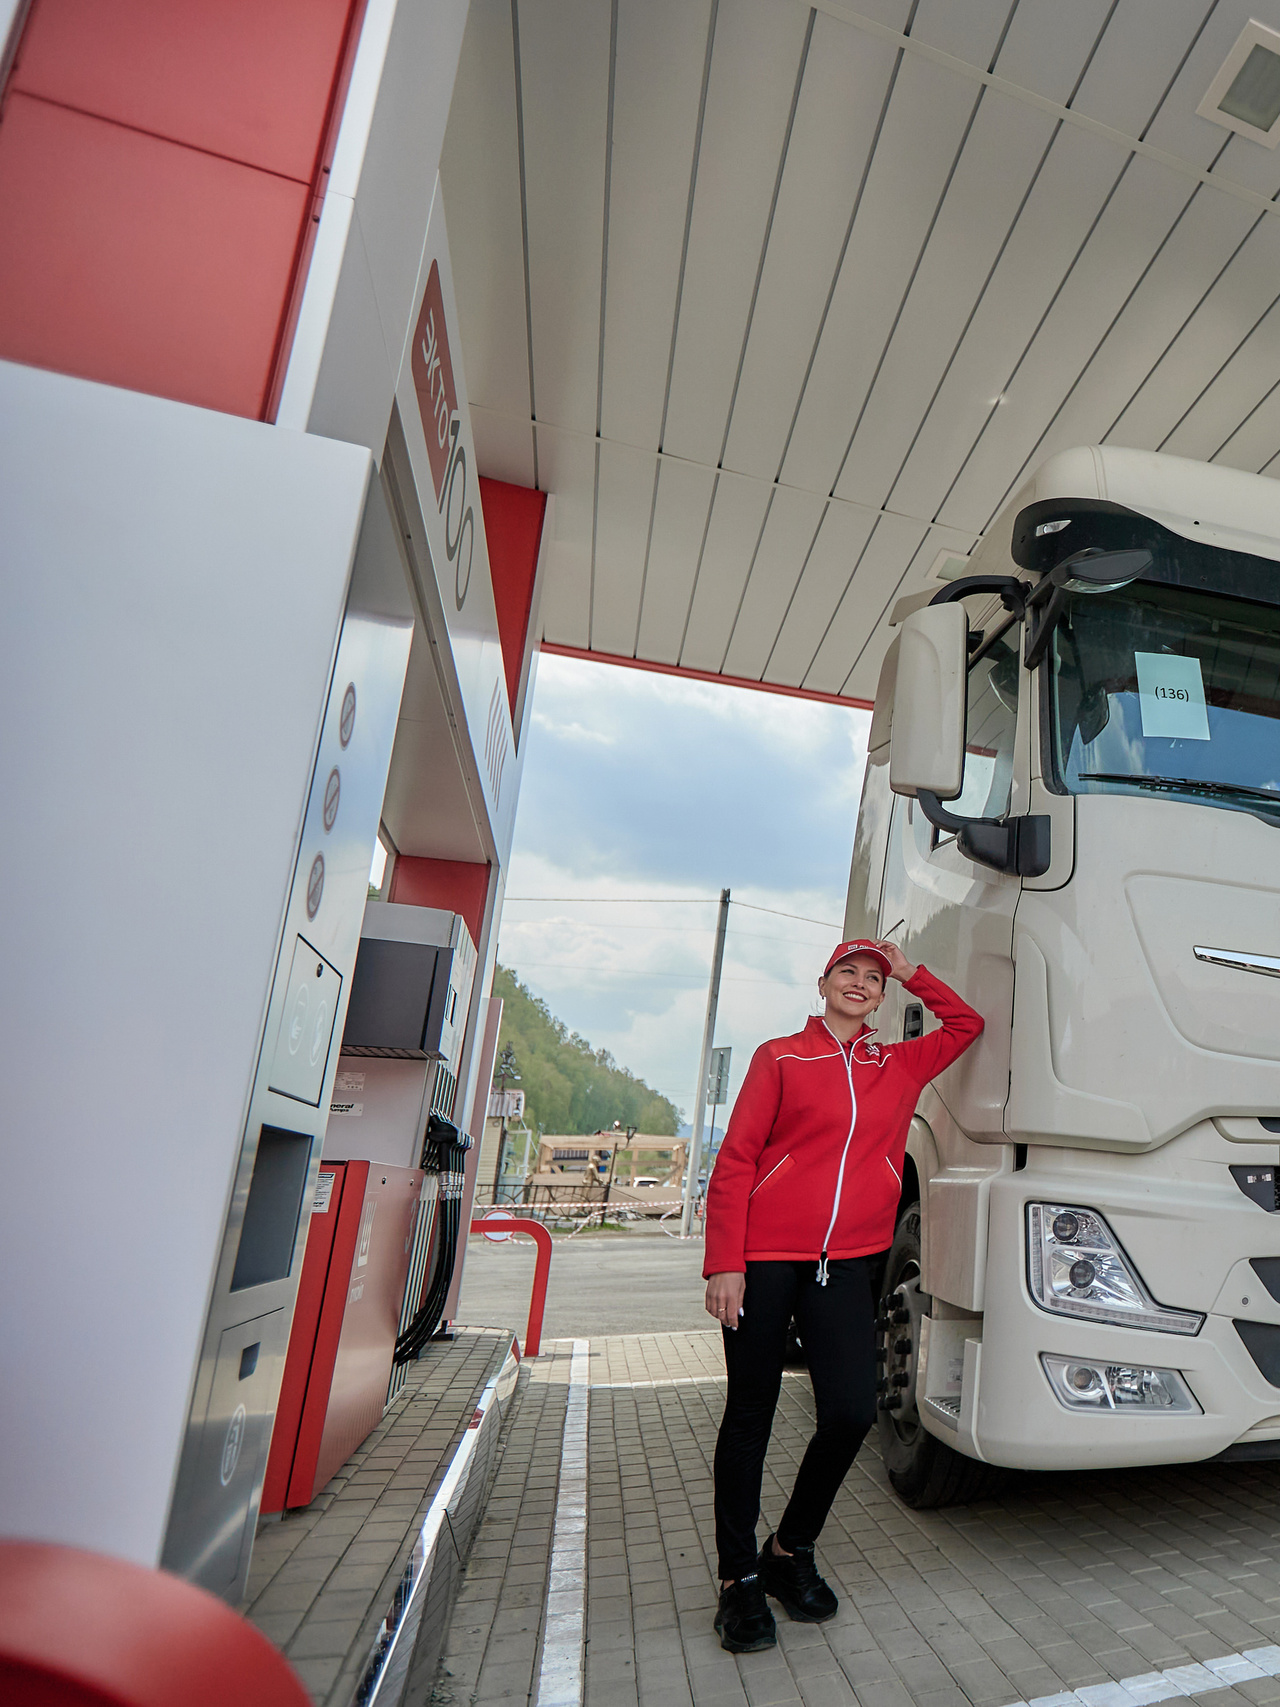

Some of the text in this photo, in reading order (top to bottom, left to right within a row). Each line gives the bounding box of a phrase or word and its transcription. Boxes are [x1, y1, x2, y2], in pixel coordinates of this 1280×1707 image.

[421, 307, 474, 612] ЭКТО 100
[1154, 685, 1190, 703] (136)
